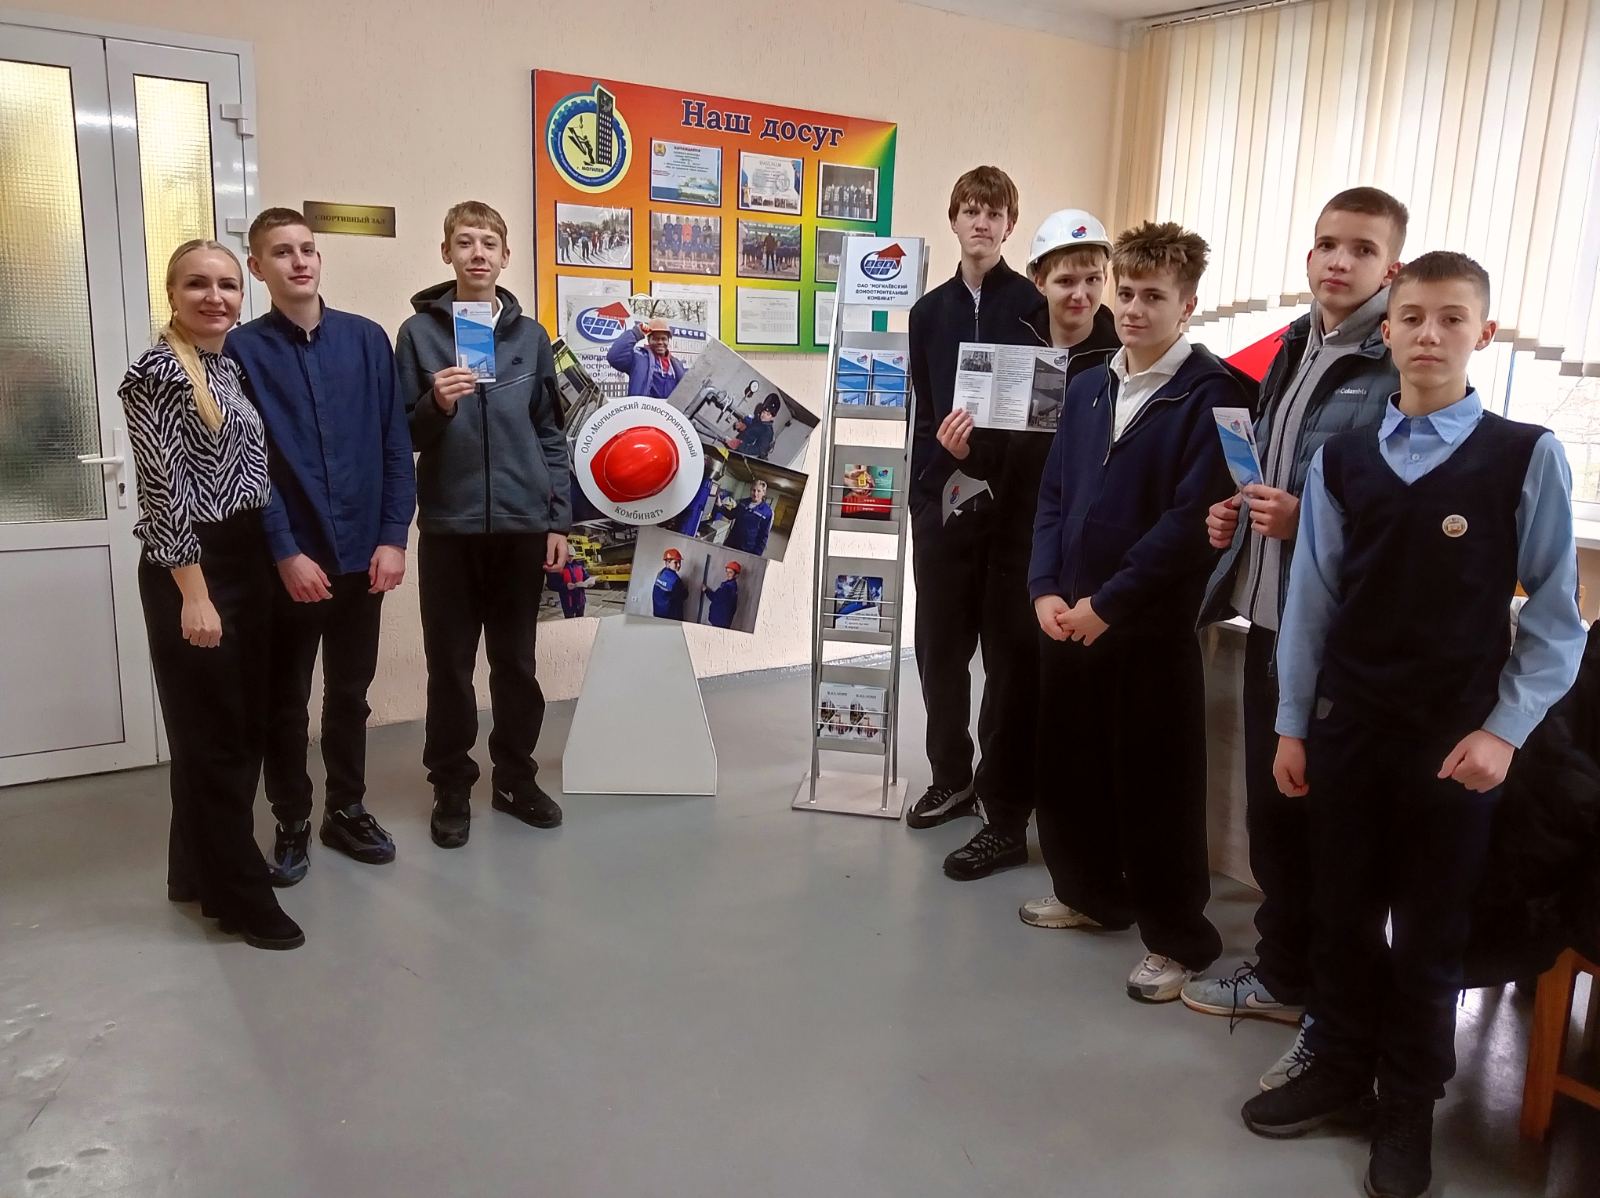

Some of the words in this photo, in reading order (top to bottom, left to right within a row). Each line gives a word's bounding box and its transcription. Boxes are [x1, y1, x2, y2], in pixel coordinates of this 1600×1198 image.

[681, 99, 751, 134] Наш
[760, 118, 844, 152] досуг
[315, 215, 370, 224] СПОРТИВНЫЙ
[581, 434, 594, 454] ОАО
[641, 403, 698, 458] домостроительный
